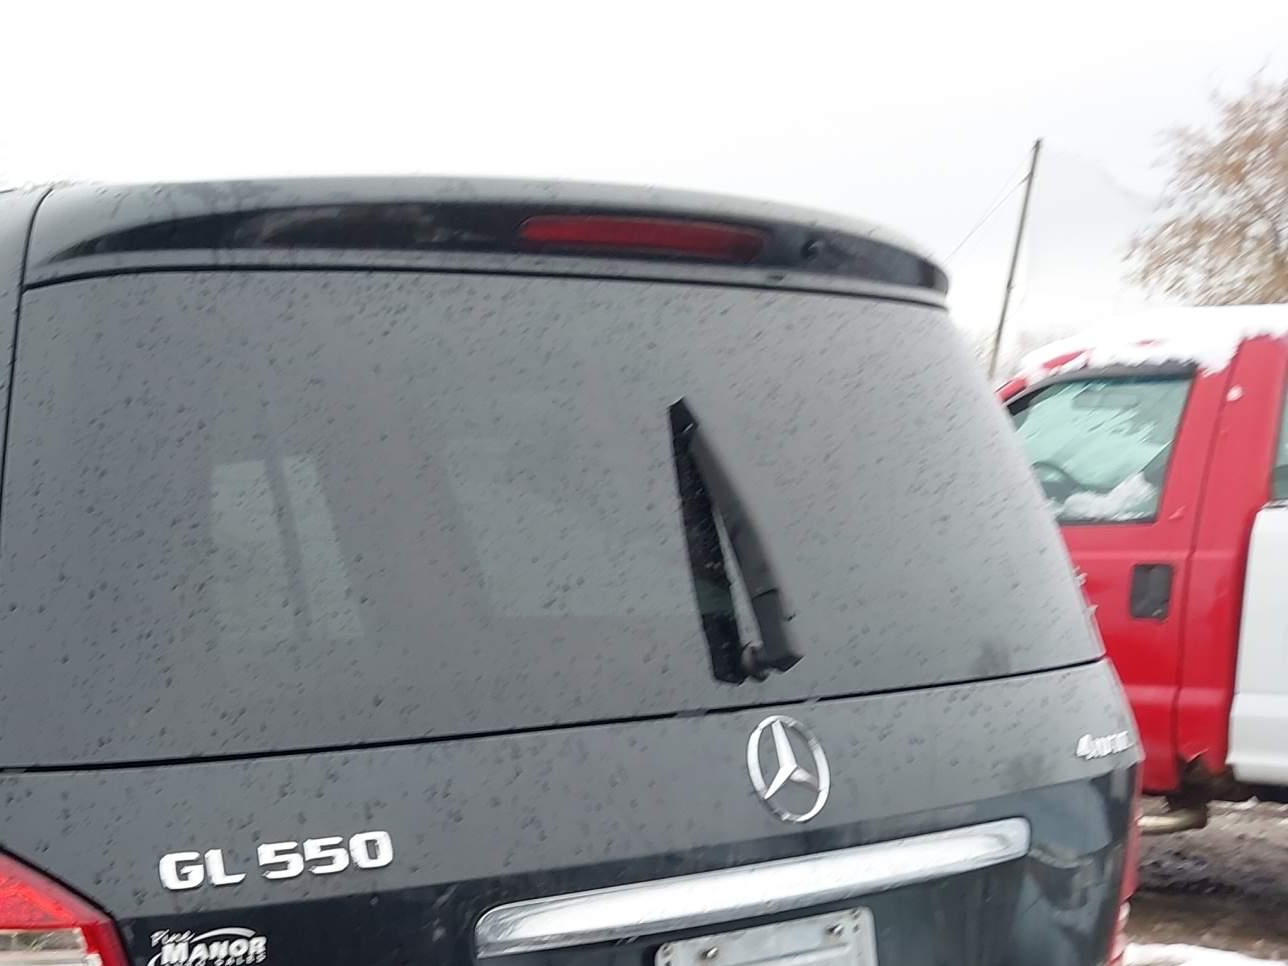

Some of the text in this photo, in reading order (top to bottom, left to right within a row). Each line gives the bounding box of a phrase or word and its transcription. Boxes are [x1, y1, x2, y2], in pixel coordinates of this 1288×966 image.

[159, 831, 394, 890] GL 550
[160, 936, 268, 966] MANOR
